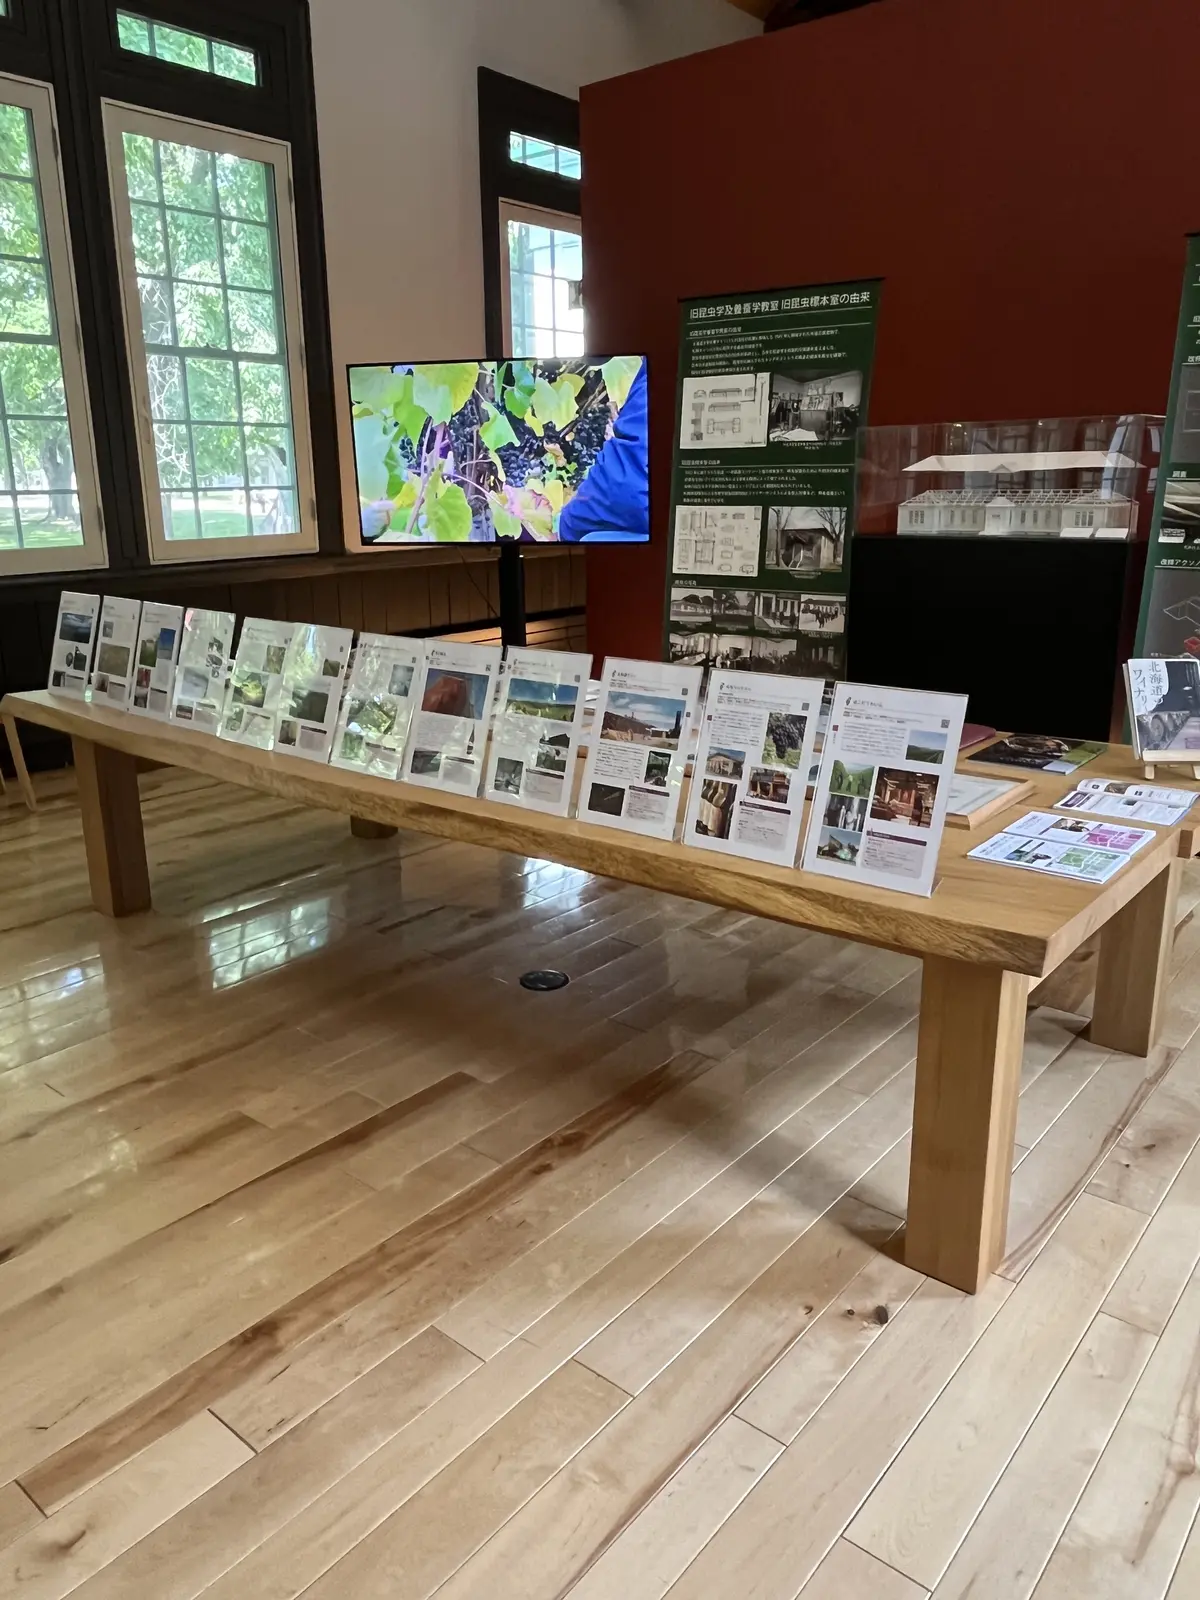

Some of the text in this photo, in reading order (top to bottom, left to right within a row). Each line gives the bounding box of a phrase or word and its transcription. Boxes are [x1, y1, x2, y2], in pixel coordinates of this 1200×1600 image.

[781, 292, 870, 310] 旧昆虫標本室の由来
